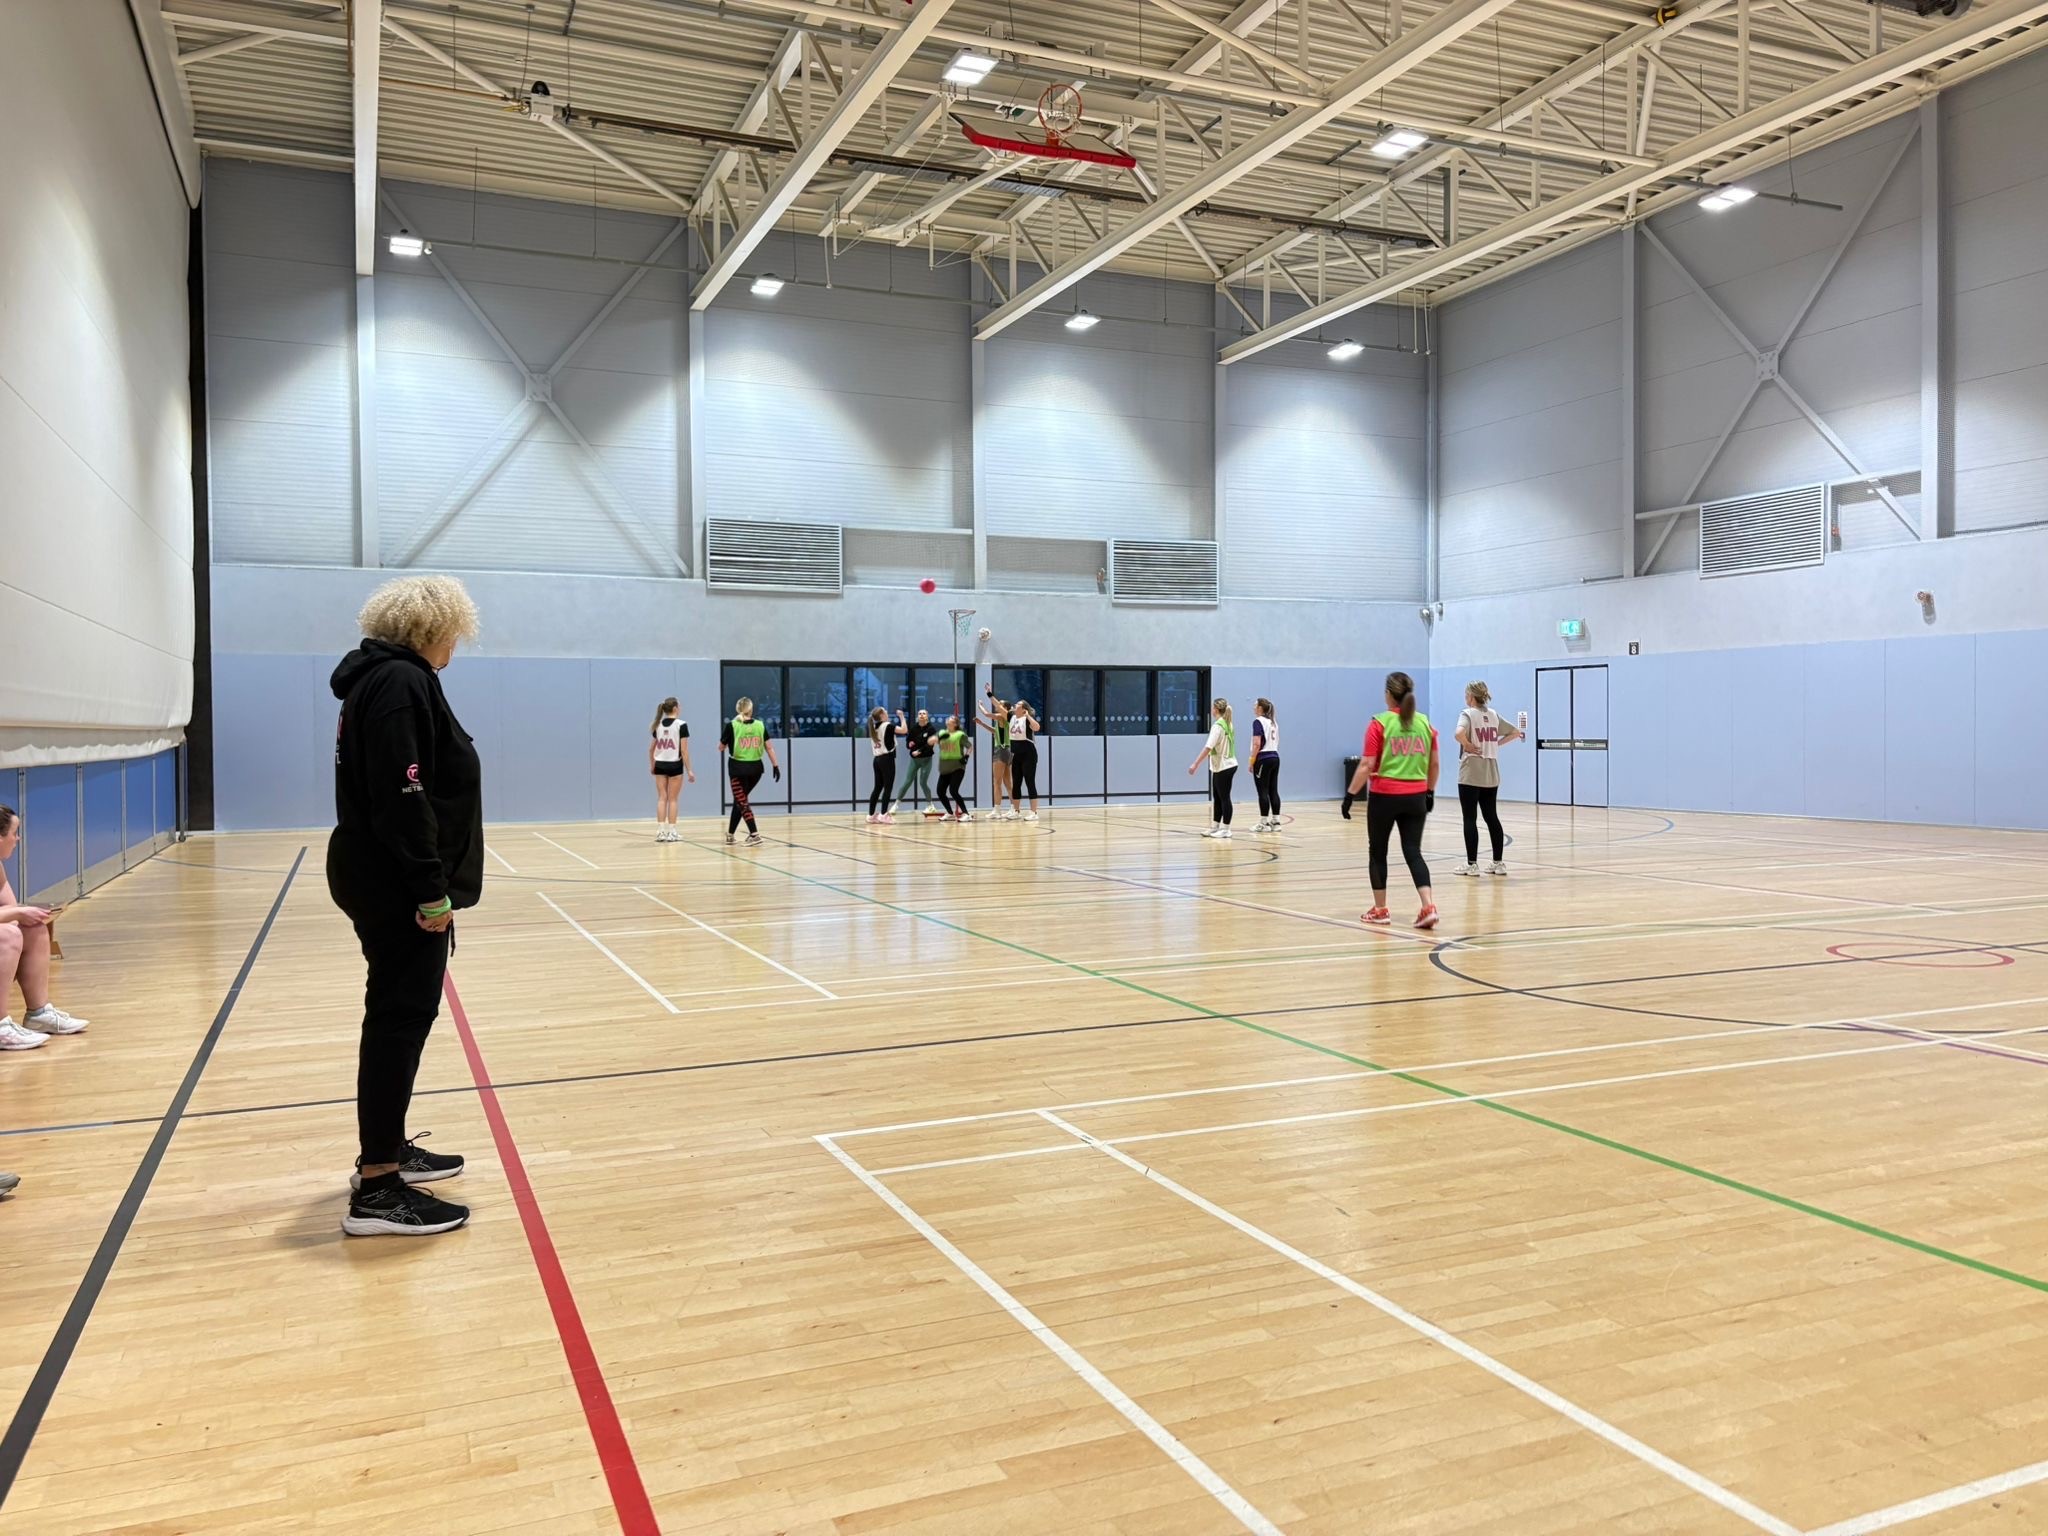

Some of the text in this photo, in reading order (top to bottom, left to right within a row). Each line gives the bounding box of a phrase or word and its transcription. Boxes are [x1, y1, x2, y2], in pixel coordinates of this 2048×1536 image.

[1474, 726, 1498, 743] WD
[656, 738, 676, 750] WA
[1389, 736, 1427, 757] WA
